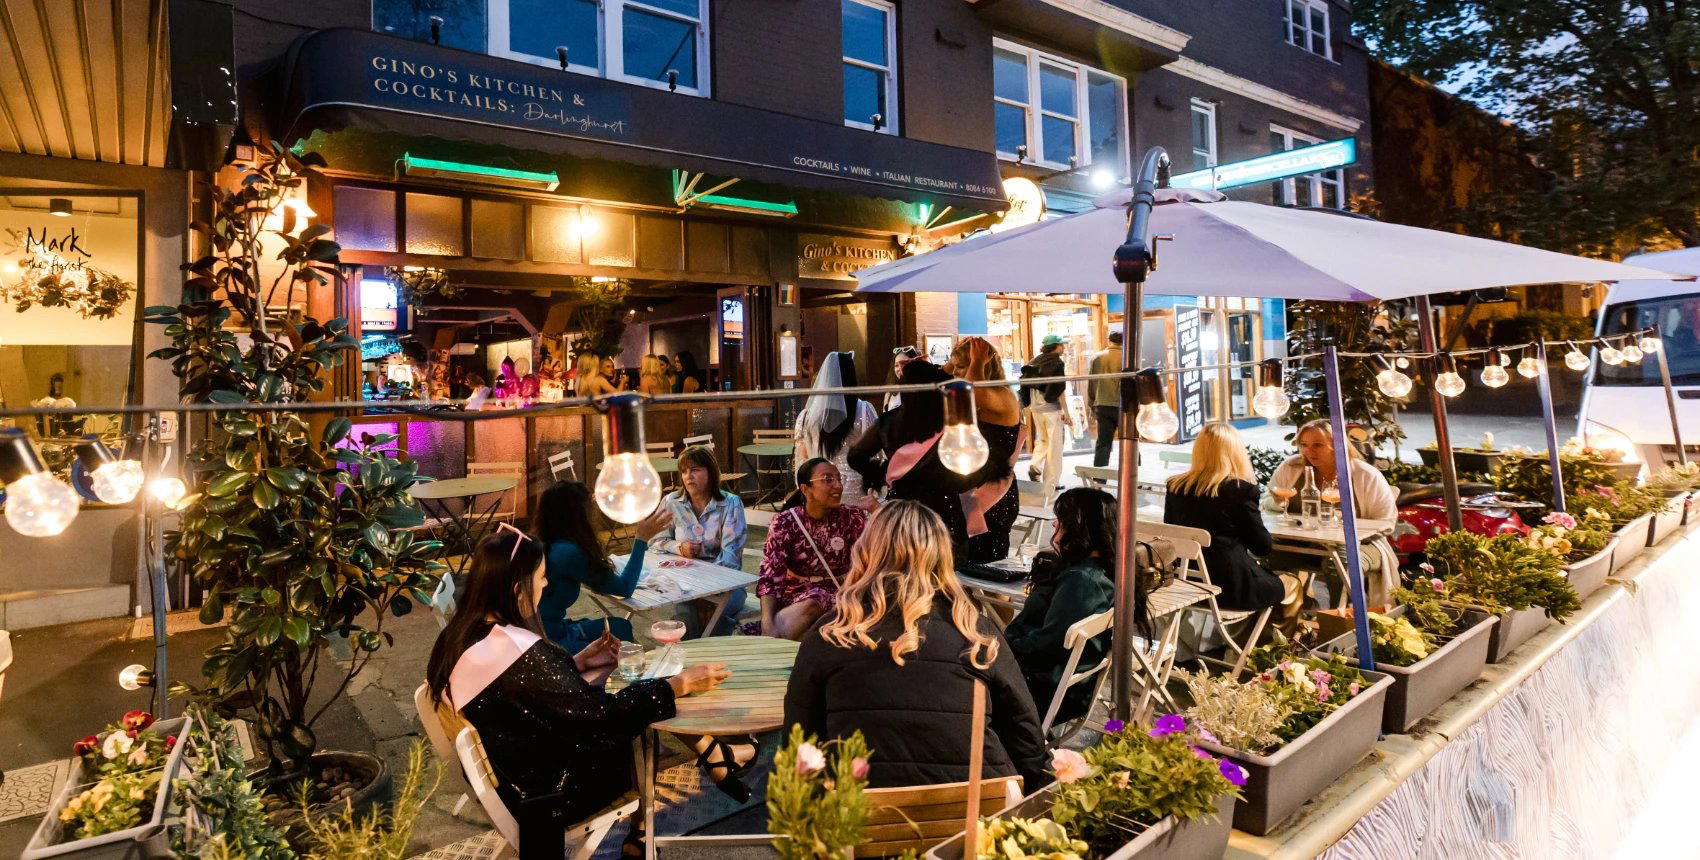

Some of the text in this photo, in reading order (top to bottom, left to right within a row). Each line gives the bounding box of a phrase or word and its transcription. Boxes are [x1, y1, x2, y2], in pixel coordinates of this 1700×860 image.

[469, 73, 563, 103] KITCHEN
[573, 93, 585, 106] &
[374, 78, 626, 135] COCKTAILS: Darlinghurst
[793, 156, 840, 172] COCKTAILS
[850, 165, 871, 177] WINE
[883, 171, 911, 184] ITALIAN
[914, 176, 958, 190] RESTAURANT
[981, 185, 996, 195] 6100
[26, 227, 92, 257] Mark
[803, 240, 894, 261] Gino's KITCHEN
[820, 260, 830, 272] &
